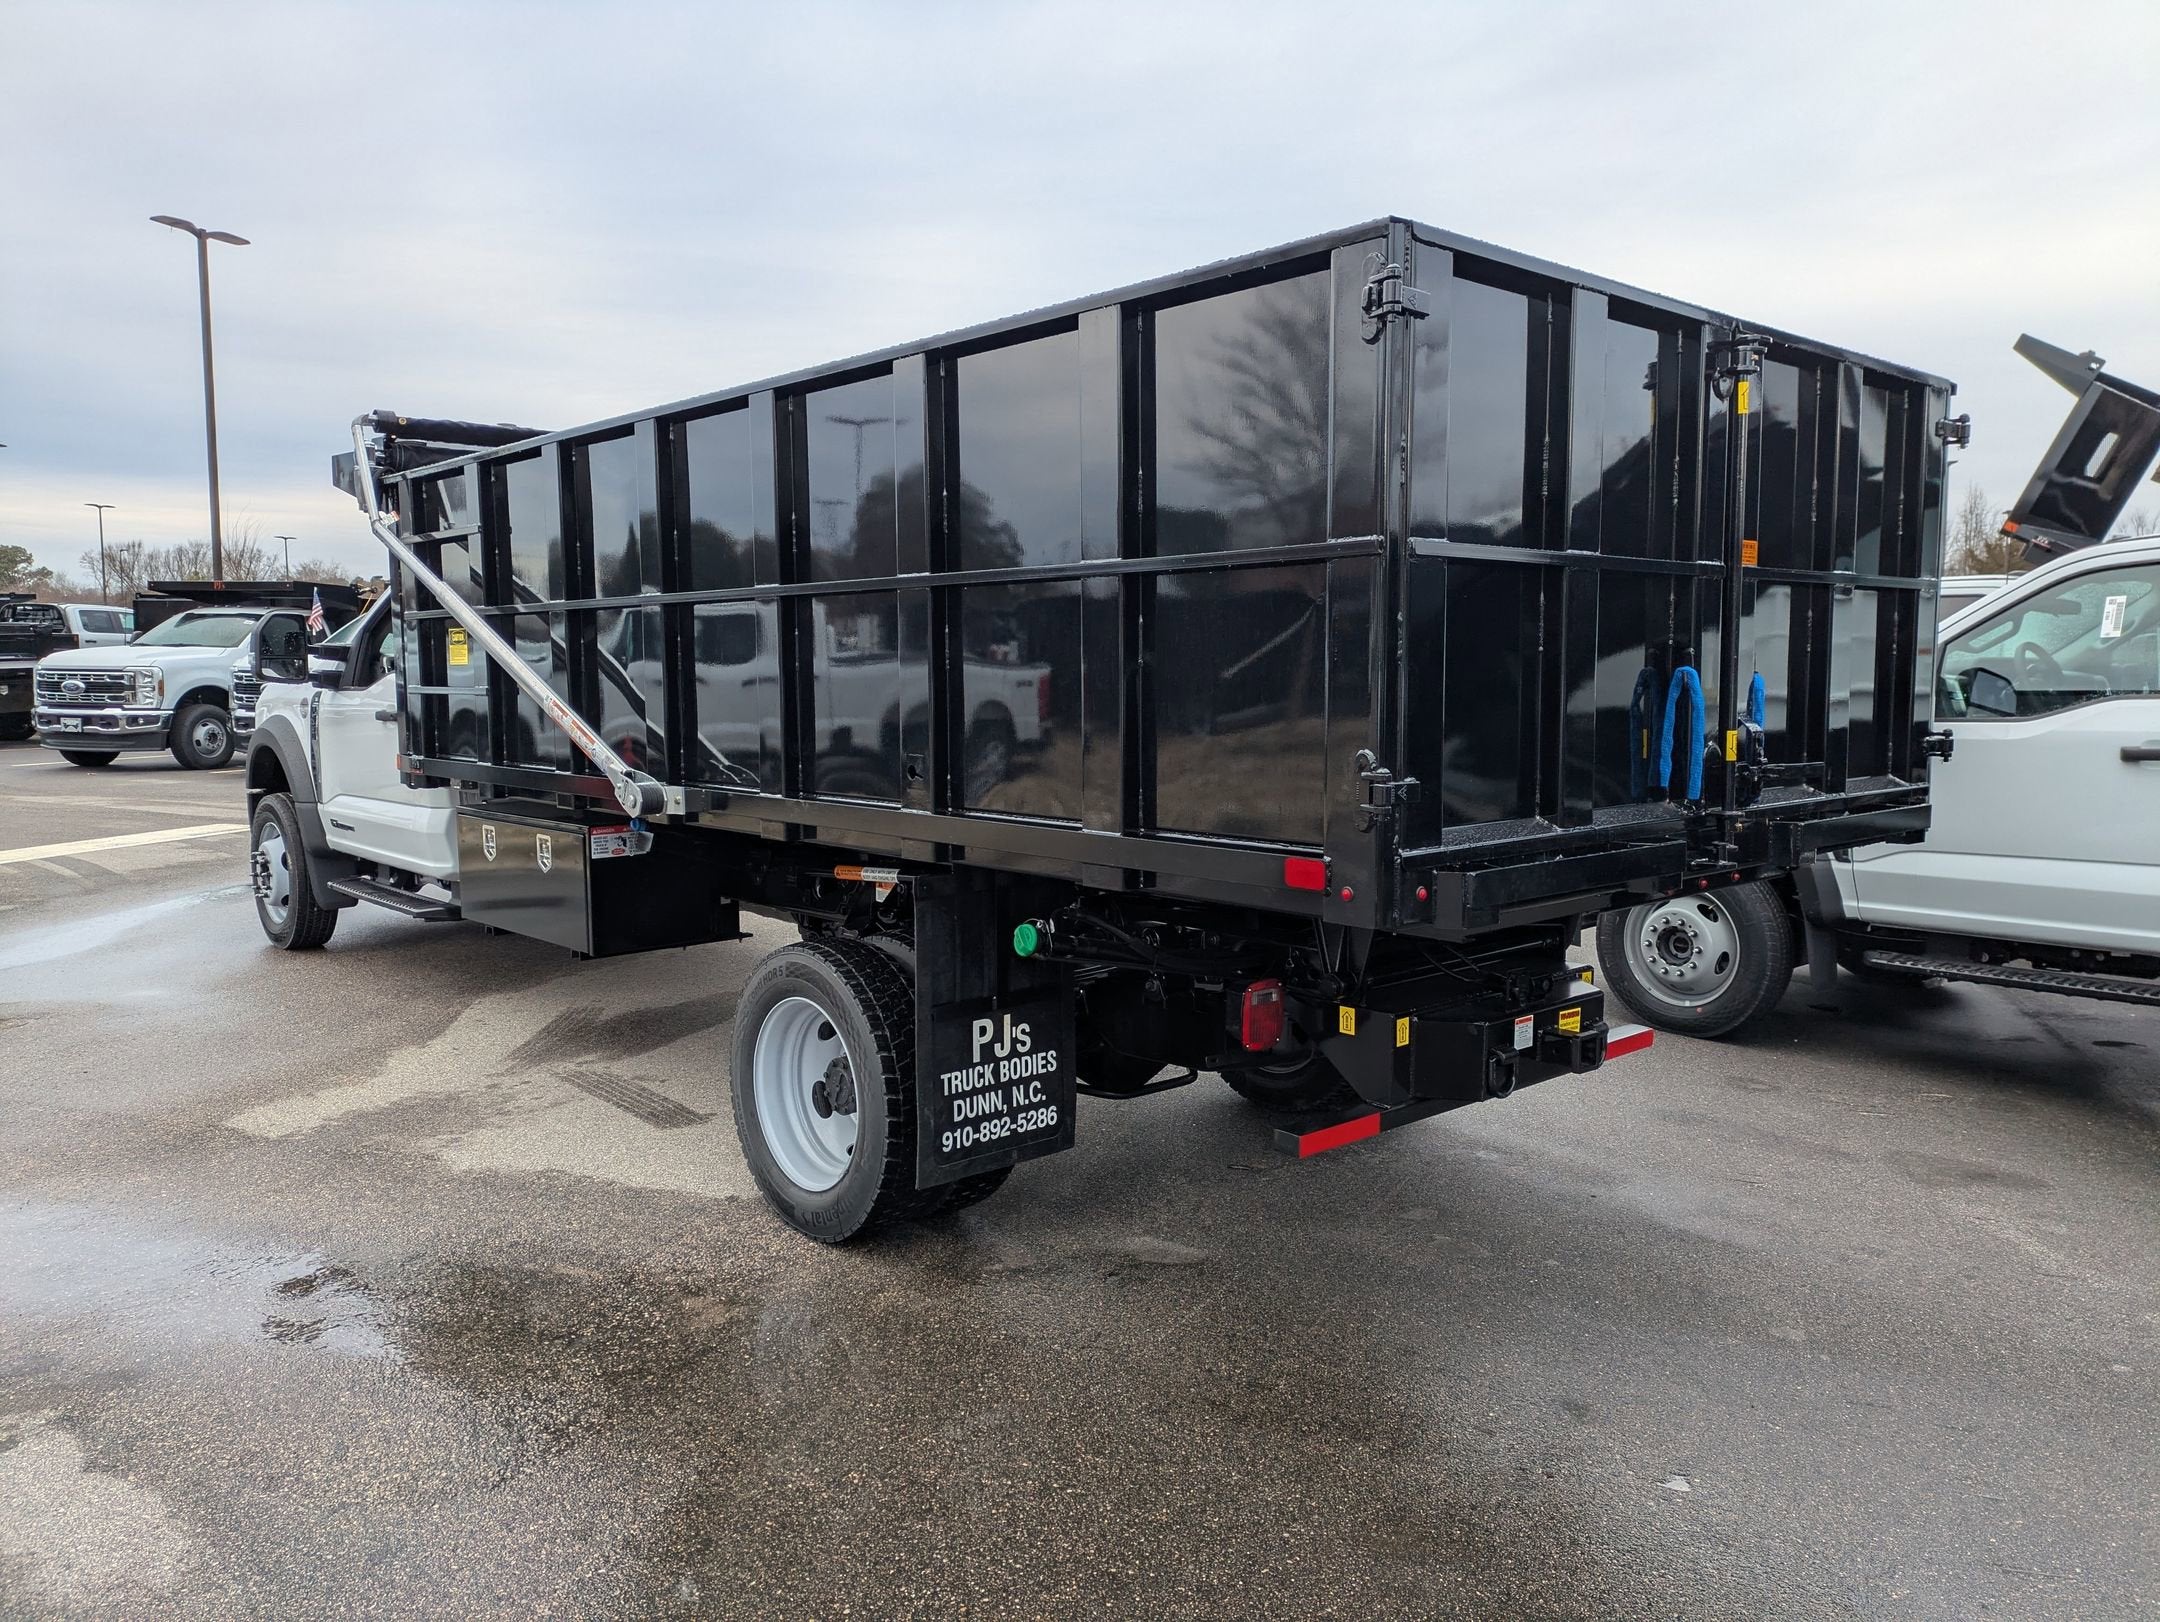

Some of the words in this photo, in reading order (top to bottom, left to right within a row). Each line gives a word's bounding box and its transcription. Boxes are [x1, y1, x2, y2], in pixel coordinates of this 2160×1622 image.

[779, 965, 784, 977] 5
[972, 1013, 1032, 1063] PJ's
[940, 1063, 995, 1097] TRUCK
[1000, 1050, 1057, 1083] BODIES
[953, 1090, 1007, 1122] DUNN,
[1012, 1081, 1046, 1107] N.C.
[942, 1105, 1058, 1153] 910-892-5286
